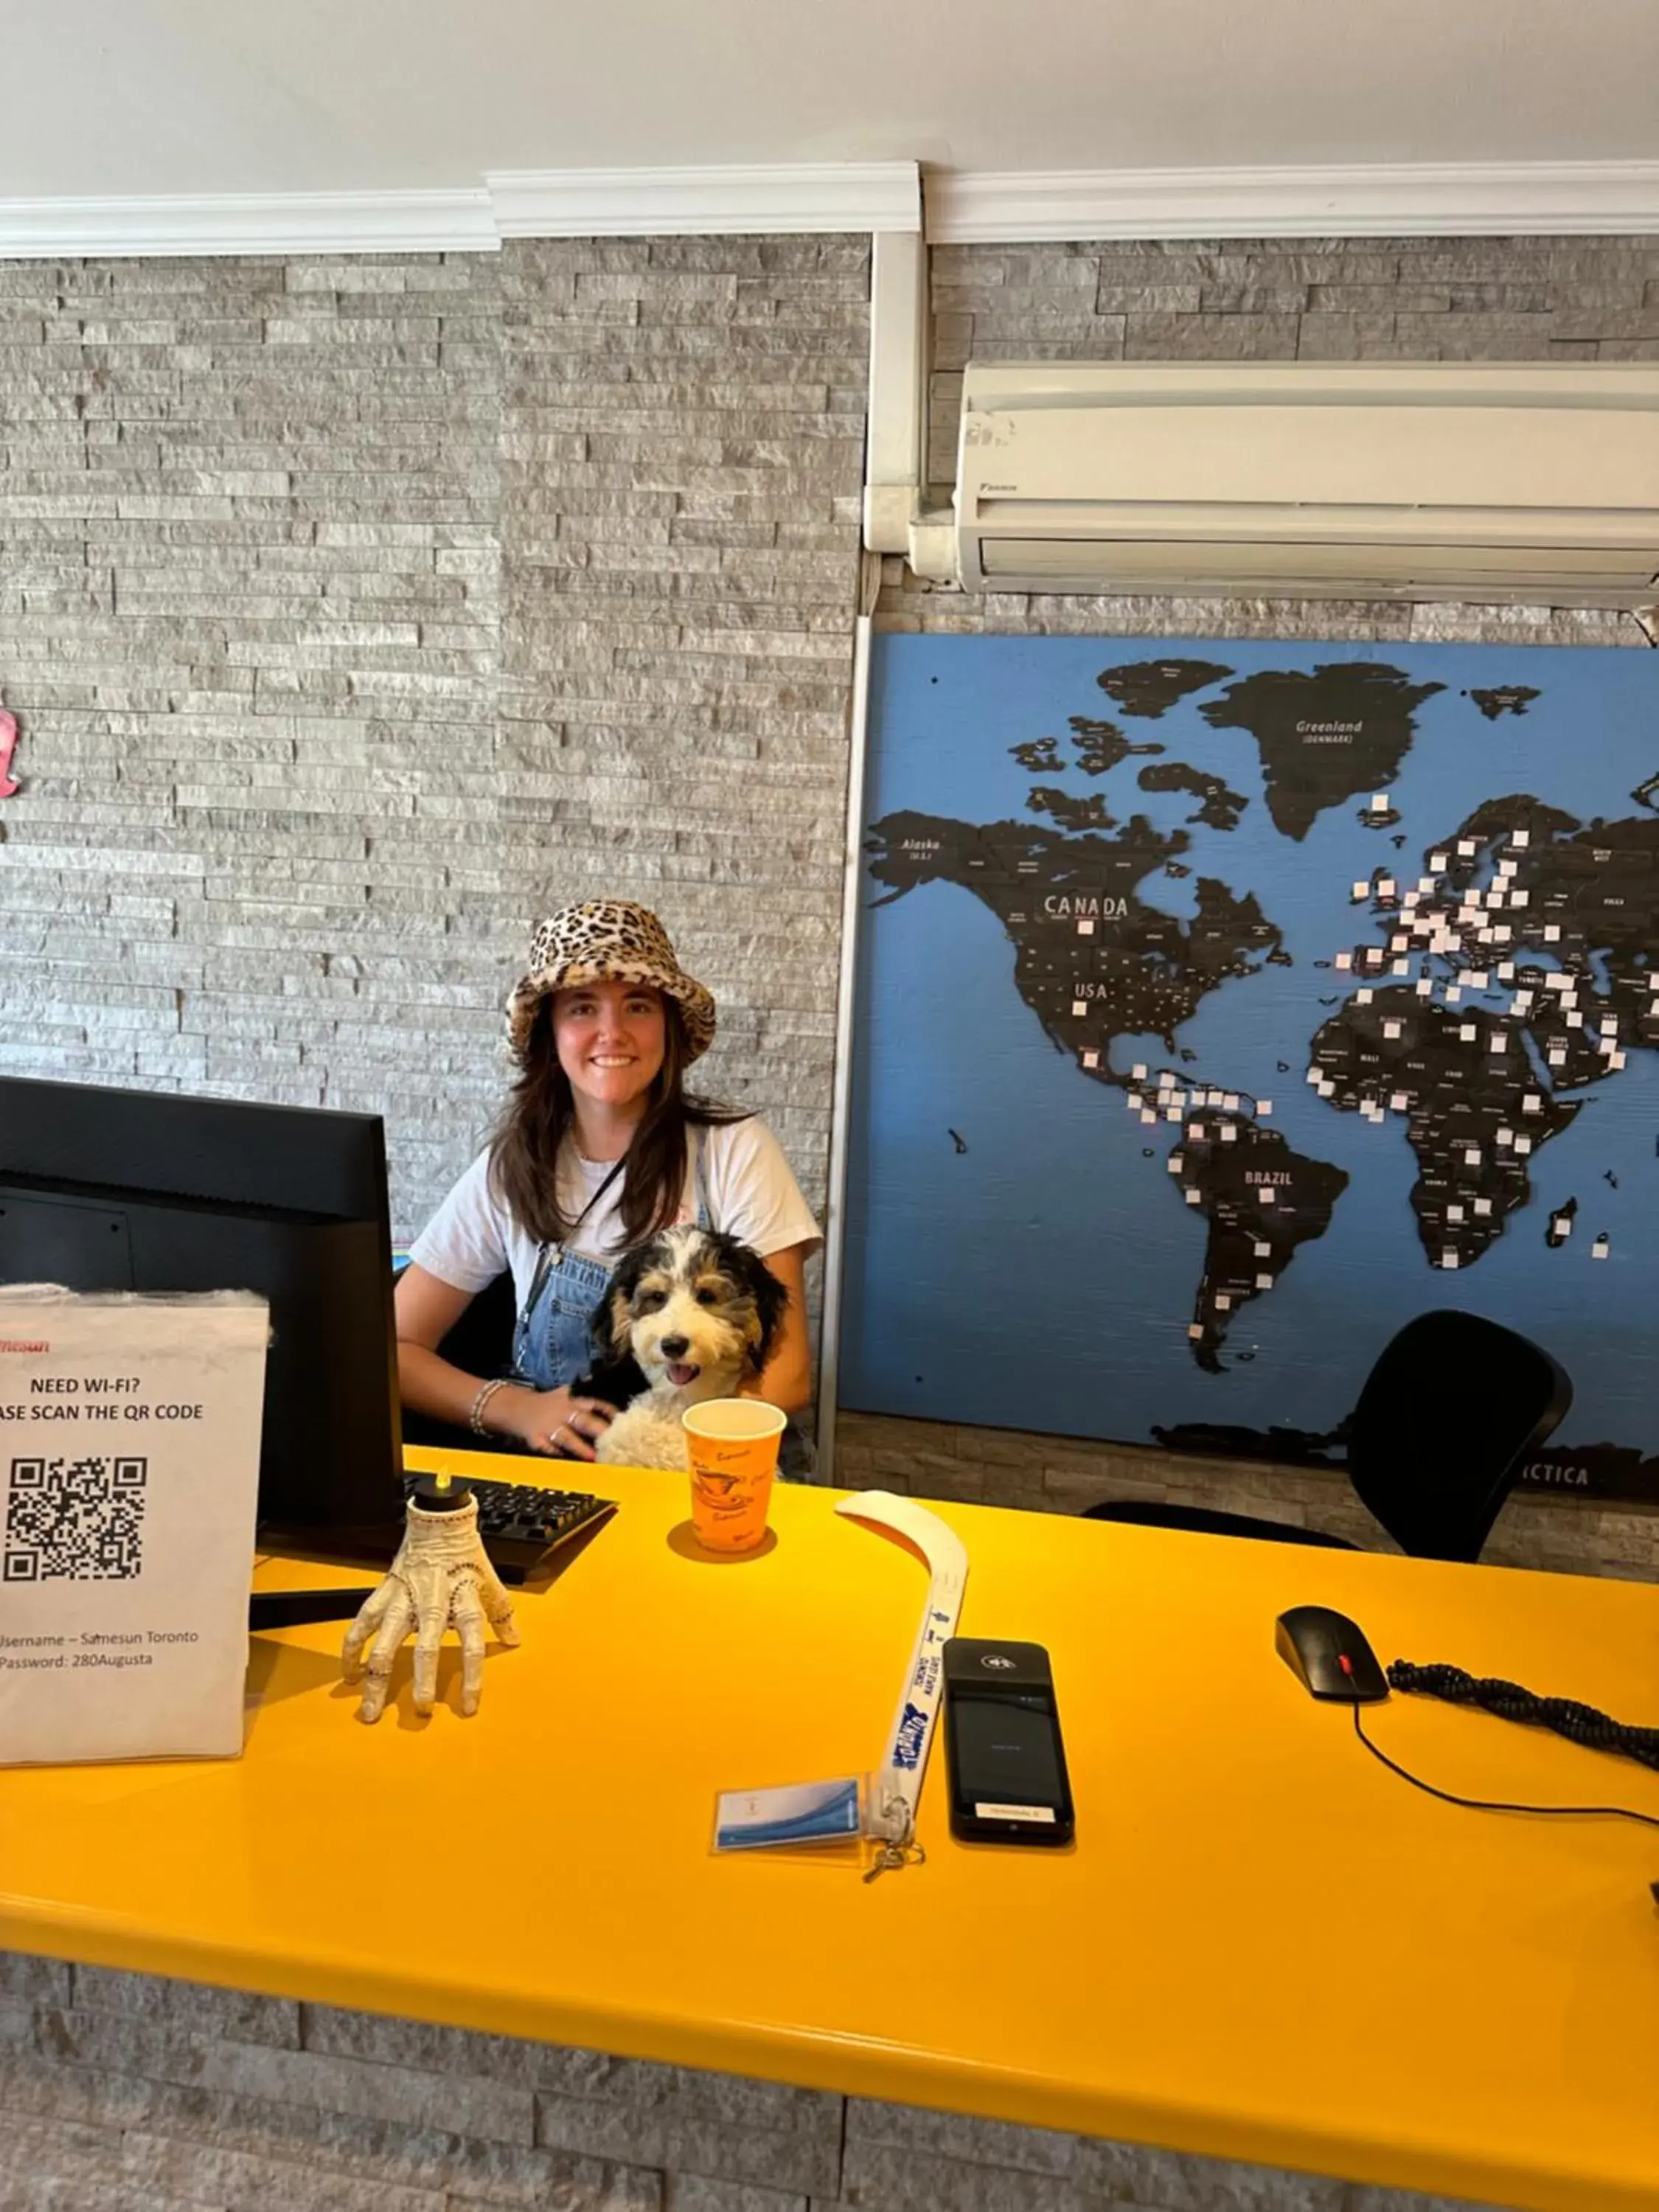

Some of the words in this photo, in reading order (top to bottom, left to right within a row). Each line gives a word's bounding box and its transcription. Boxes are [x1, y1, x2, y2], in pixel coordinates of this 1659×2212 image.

[1296, 720, 1363, 732] Greenland
[901, 839, 940, 849] Alaska
[1044, 895, 1127, 917] CANADA
[1075, 983, 1107, 998] USA
[1245, 1171, 1293, 1185] BRAZIL
[31, 1378, 79, 1393] NEED
[84, 1377, 140, 1393] WI-FI?
[31, 1405, 79, 1420] SCAN
[85, 1405, 119, 1419] THE
[124, 1405, 149, 1421] QR
[155, 1405, 204, 1419] CODE
[80, 1631, 142, 1645] Samesun
[147, 1630, 199, 1644] Toronto
[72, 1654, 153, 1668] 280Augusta
